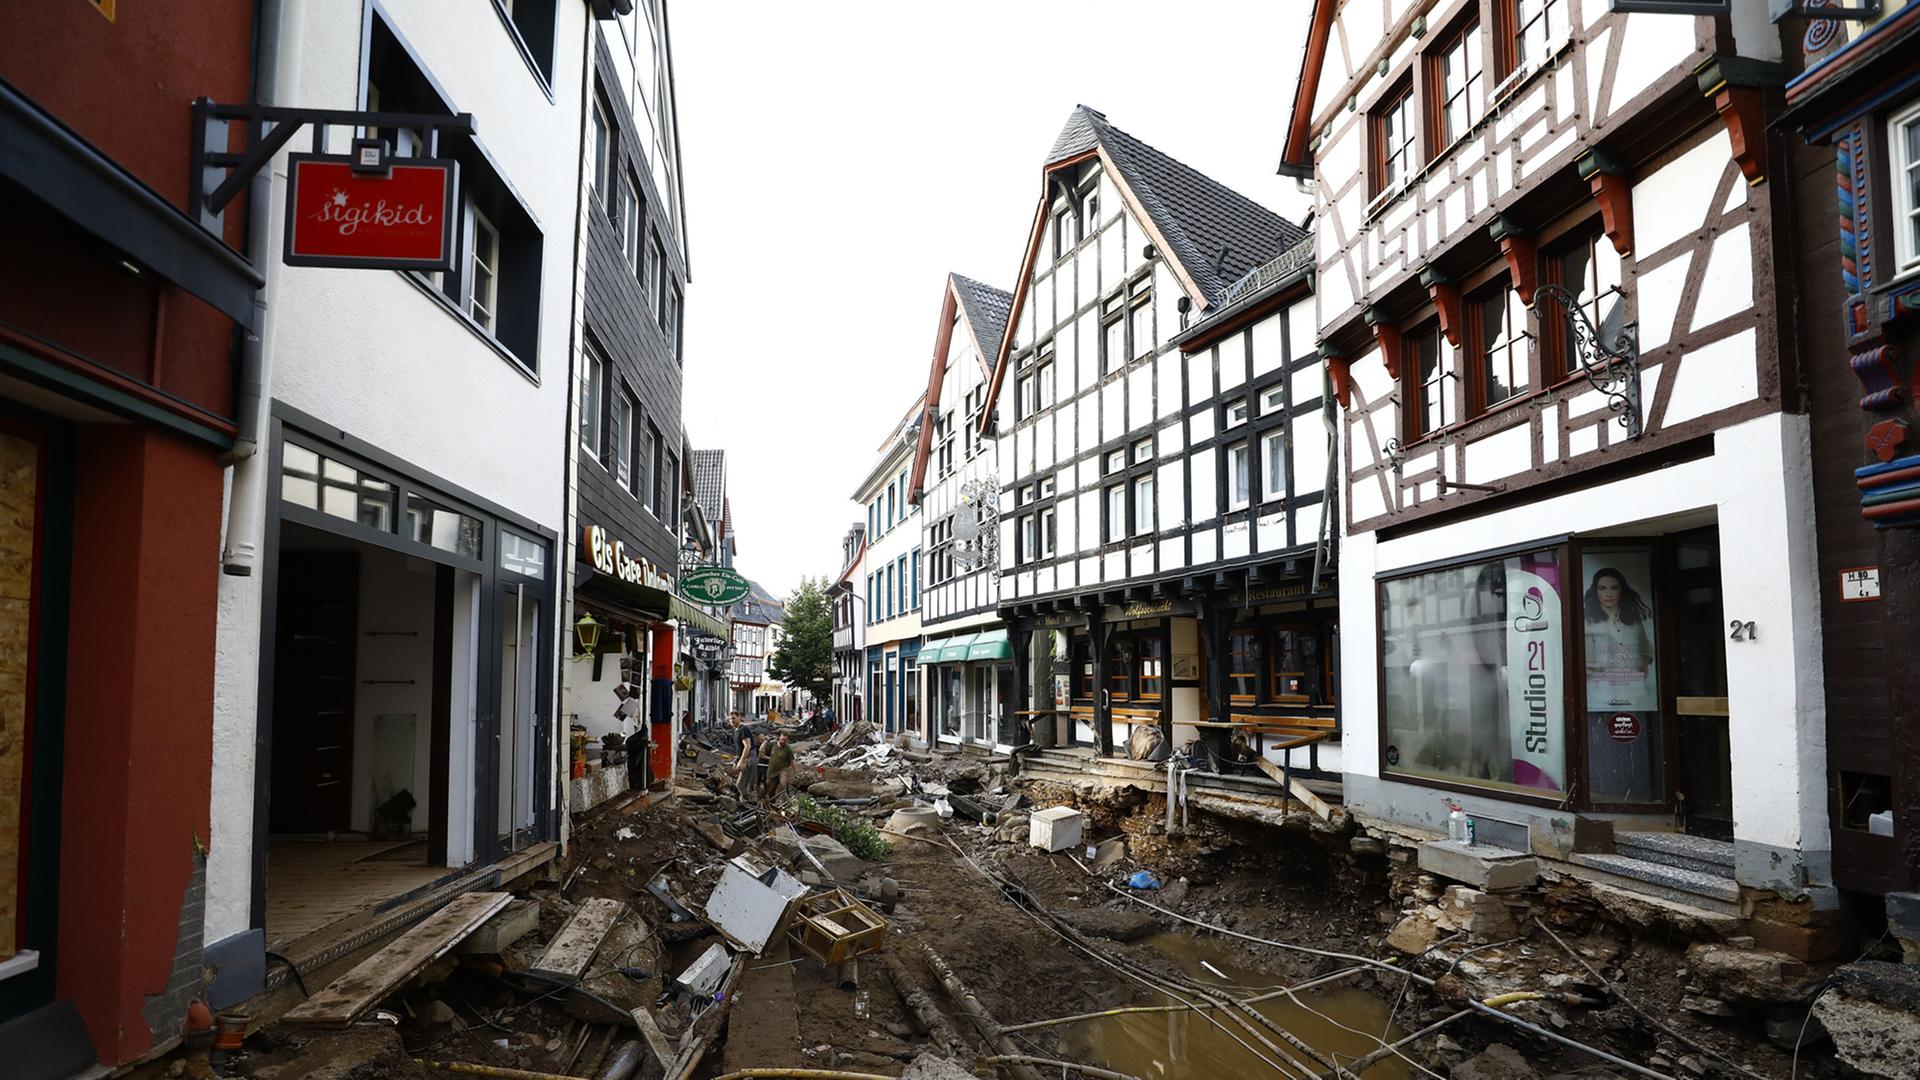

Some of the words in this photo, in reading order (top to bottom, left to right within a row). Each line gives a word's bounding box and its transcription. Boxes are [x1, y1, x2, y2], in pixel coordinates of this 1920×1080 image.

[308, 199, 433, 236] sigikid
[1249, 584, 1306, 601] Restaurant
[1729, 619, 1756, 641] 21
[1527, 640, 1545, 672] 21
[1524, 674, 1548, 754] Studio
